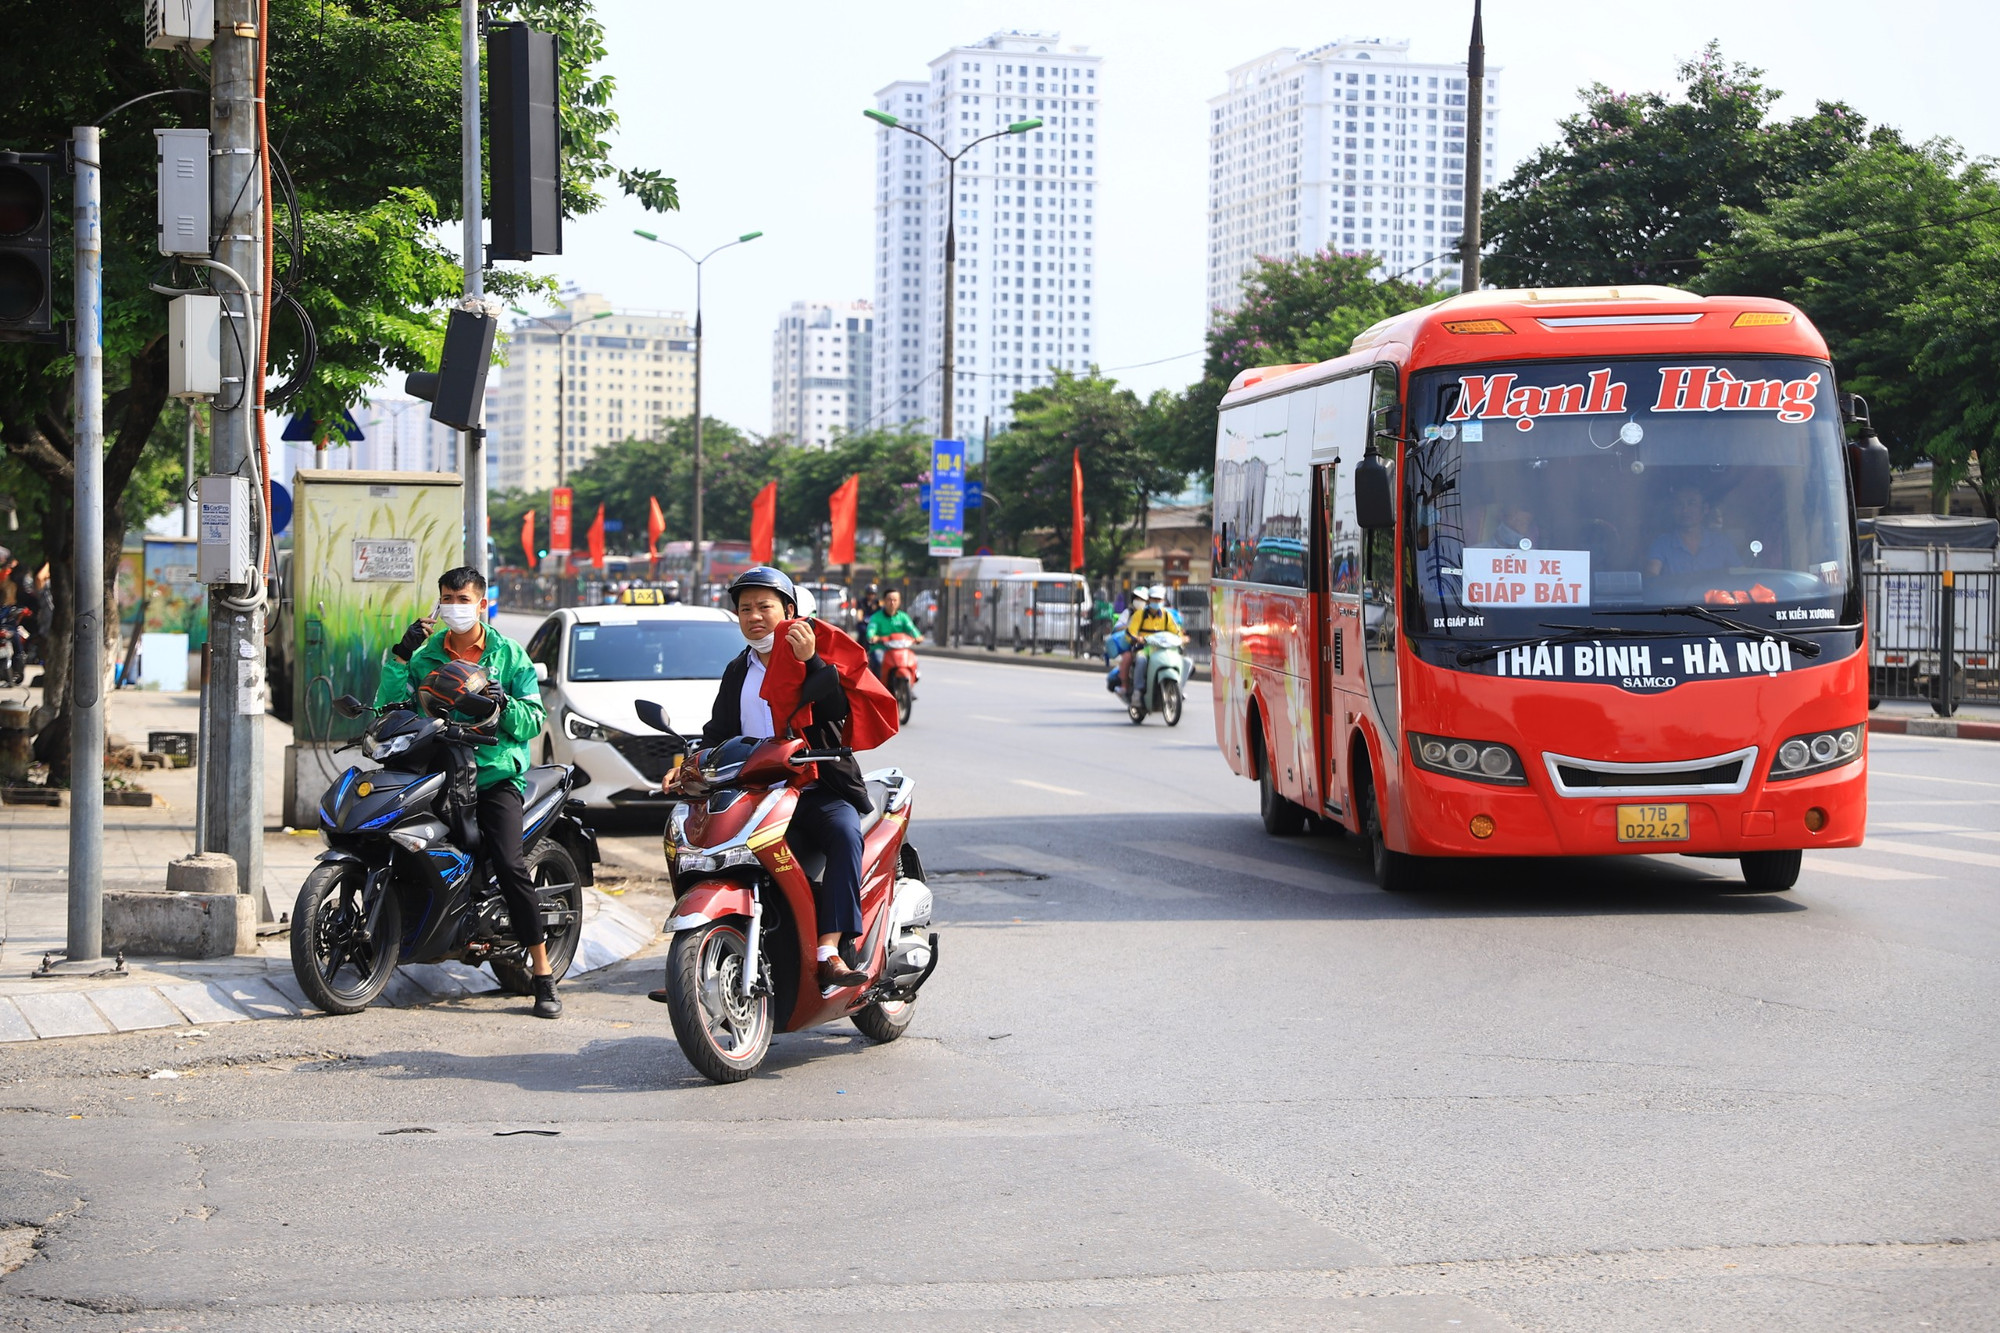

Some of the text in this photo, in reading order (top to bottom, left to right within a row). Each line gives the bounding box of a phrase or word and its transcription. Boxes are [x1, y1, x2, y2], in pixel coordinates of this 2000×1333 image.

[1446, 366, 1821, 432] Mạnh Hùng
[1492, 554, 1561, 575] BẾN XE
[1468, 577, 1582, 603] GIÁP BÁT
[1434, 615, 1485, 628] BX GIÁP BÁT
[1776, 611, 1787, 621] BX
[1492, 640, 1563, 676] THÁI
[1575, 640, 1652, 677] BÌNH
[1683, 637, 1730, 675] HÀ
[1736, 635, 1792, 678] NỘI
[1622, 676, 1676, 688] SAMCO
[1640, 807, 1667, 821] 17B
[1625, 823, 1680, 838] 022.42
